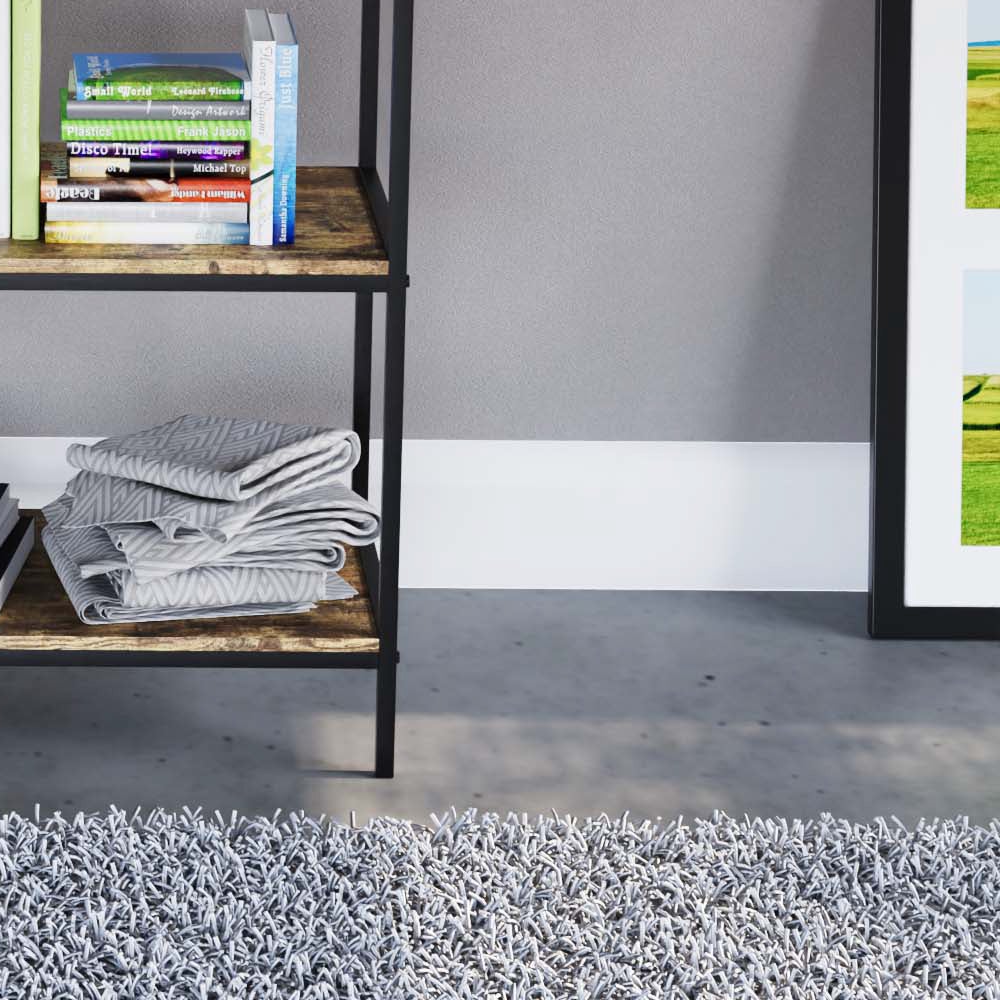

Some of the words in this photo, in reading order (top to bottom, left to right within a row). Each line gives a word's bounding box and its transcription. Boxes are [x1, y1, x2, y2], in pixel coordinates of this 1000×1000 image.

[83, 85, 114, 97] Small
[117, 85, 152, 97] World
[171, 104, 202, 119] Design
[206, 104, 247, 117] Artwork
[66, 125, 113, 137] Plastics
[177, 125, 208, 137] Frank
[213, 125, 246, 137] Jason
[70, 142, 108, 155] Disco
[112, 142, 153, 156] Time!
[193, 163, 228, 173] Michael
[229, 163, 247, 174] Top
[279, 208, 288, 242] Samantha
